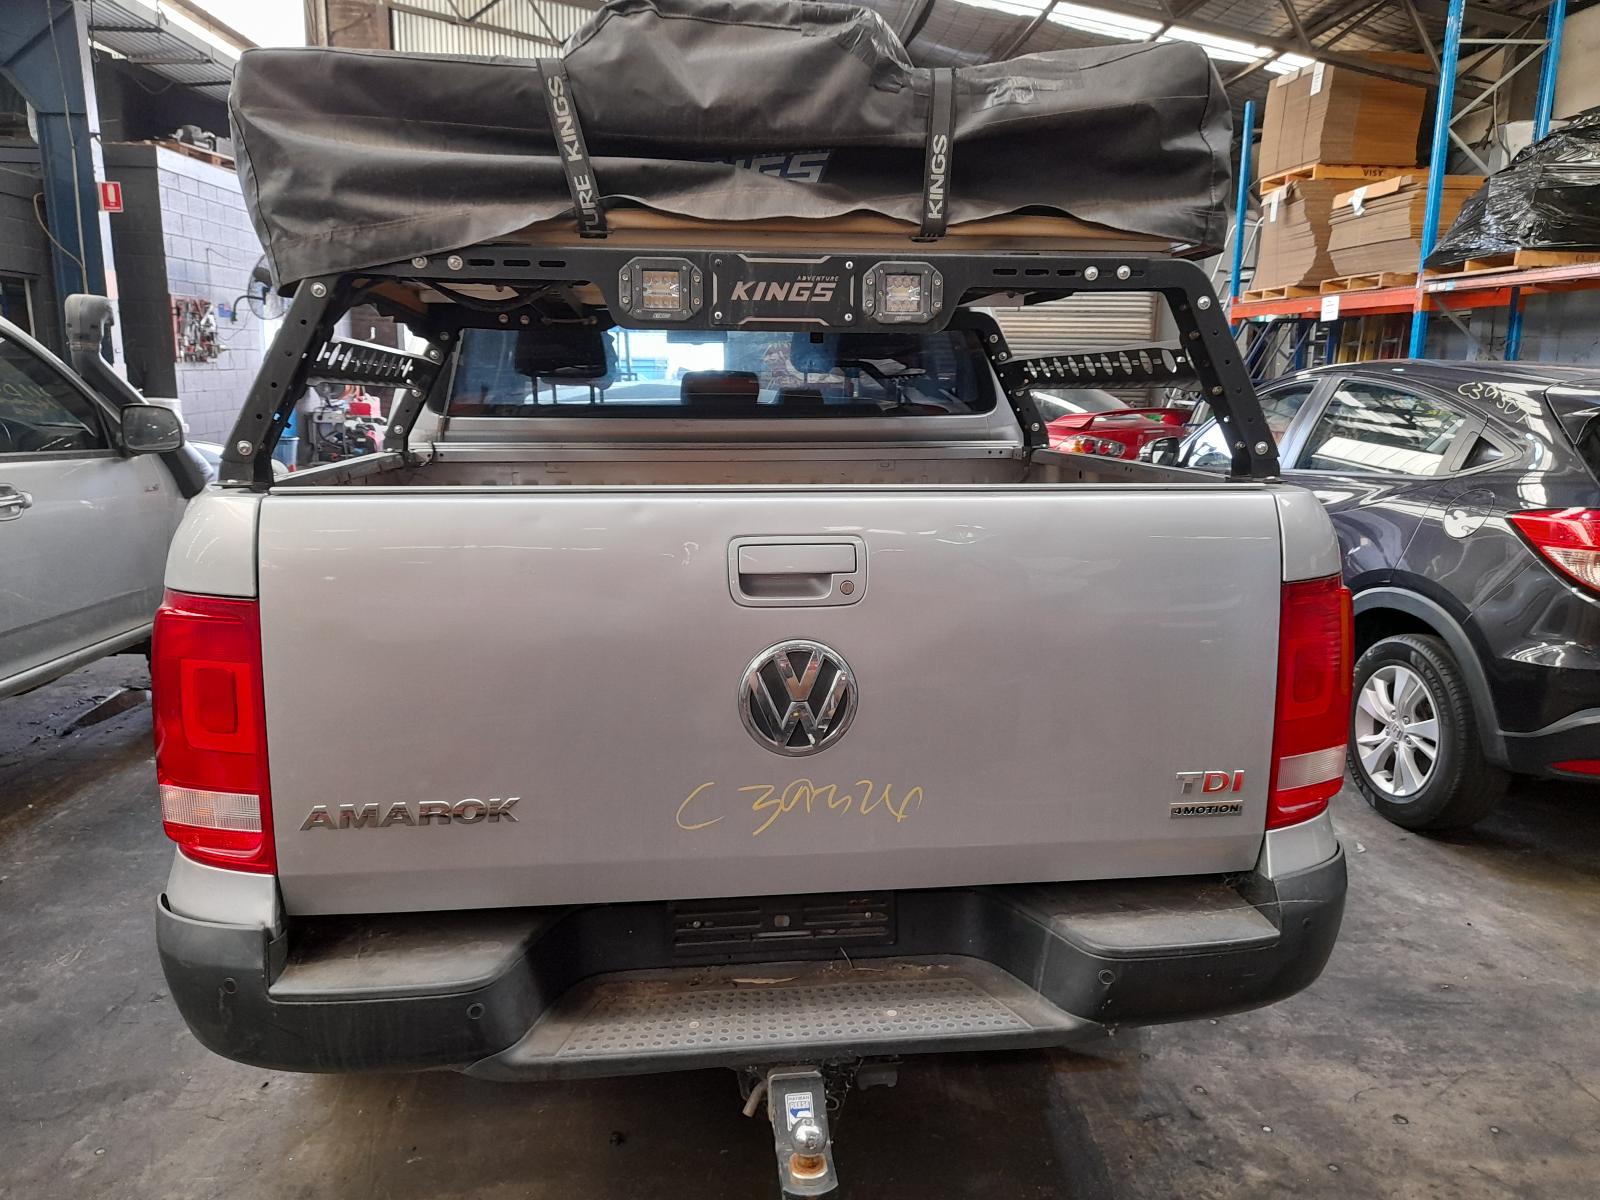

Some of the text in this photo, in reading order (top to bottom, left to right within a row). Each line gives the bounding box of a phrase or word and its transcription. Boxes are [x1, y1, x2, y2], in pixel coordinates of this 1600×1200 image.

[548, 75, 583, 162] KINGS
[927, 134, 948, 219] KINGS
[1362, 168, 1384, 177] VISY
[730, 281, 837, 302] KINGS
[1175, 769, 1245, 795] TDI
[299, 797, 521, 831] AMAROK
[1173, 803, 1241, 816] 4MOTION
